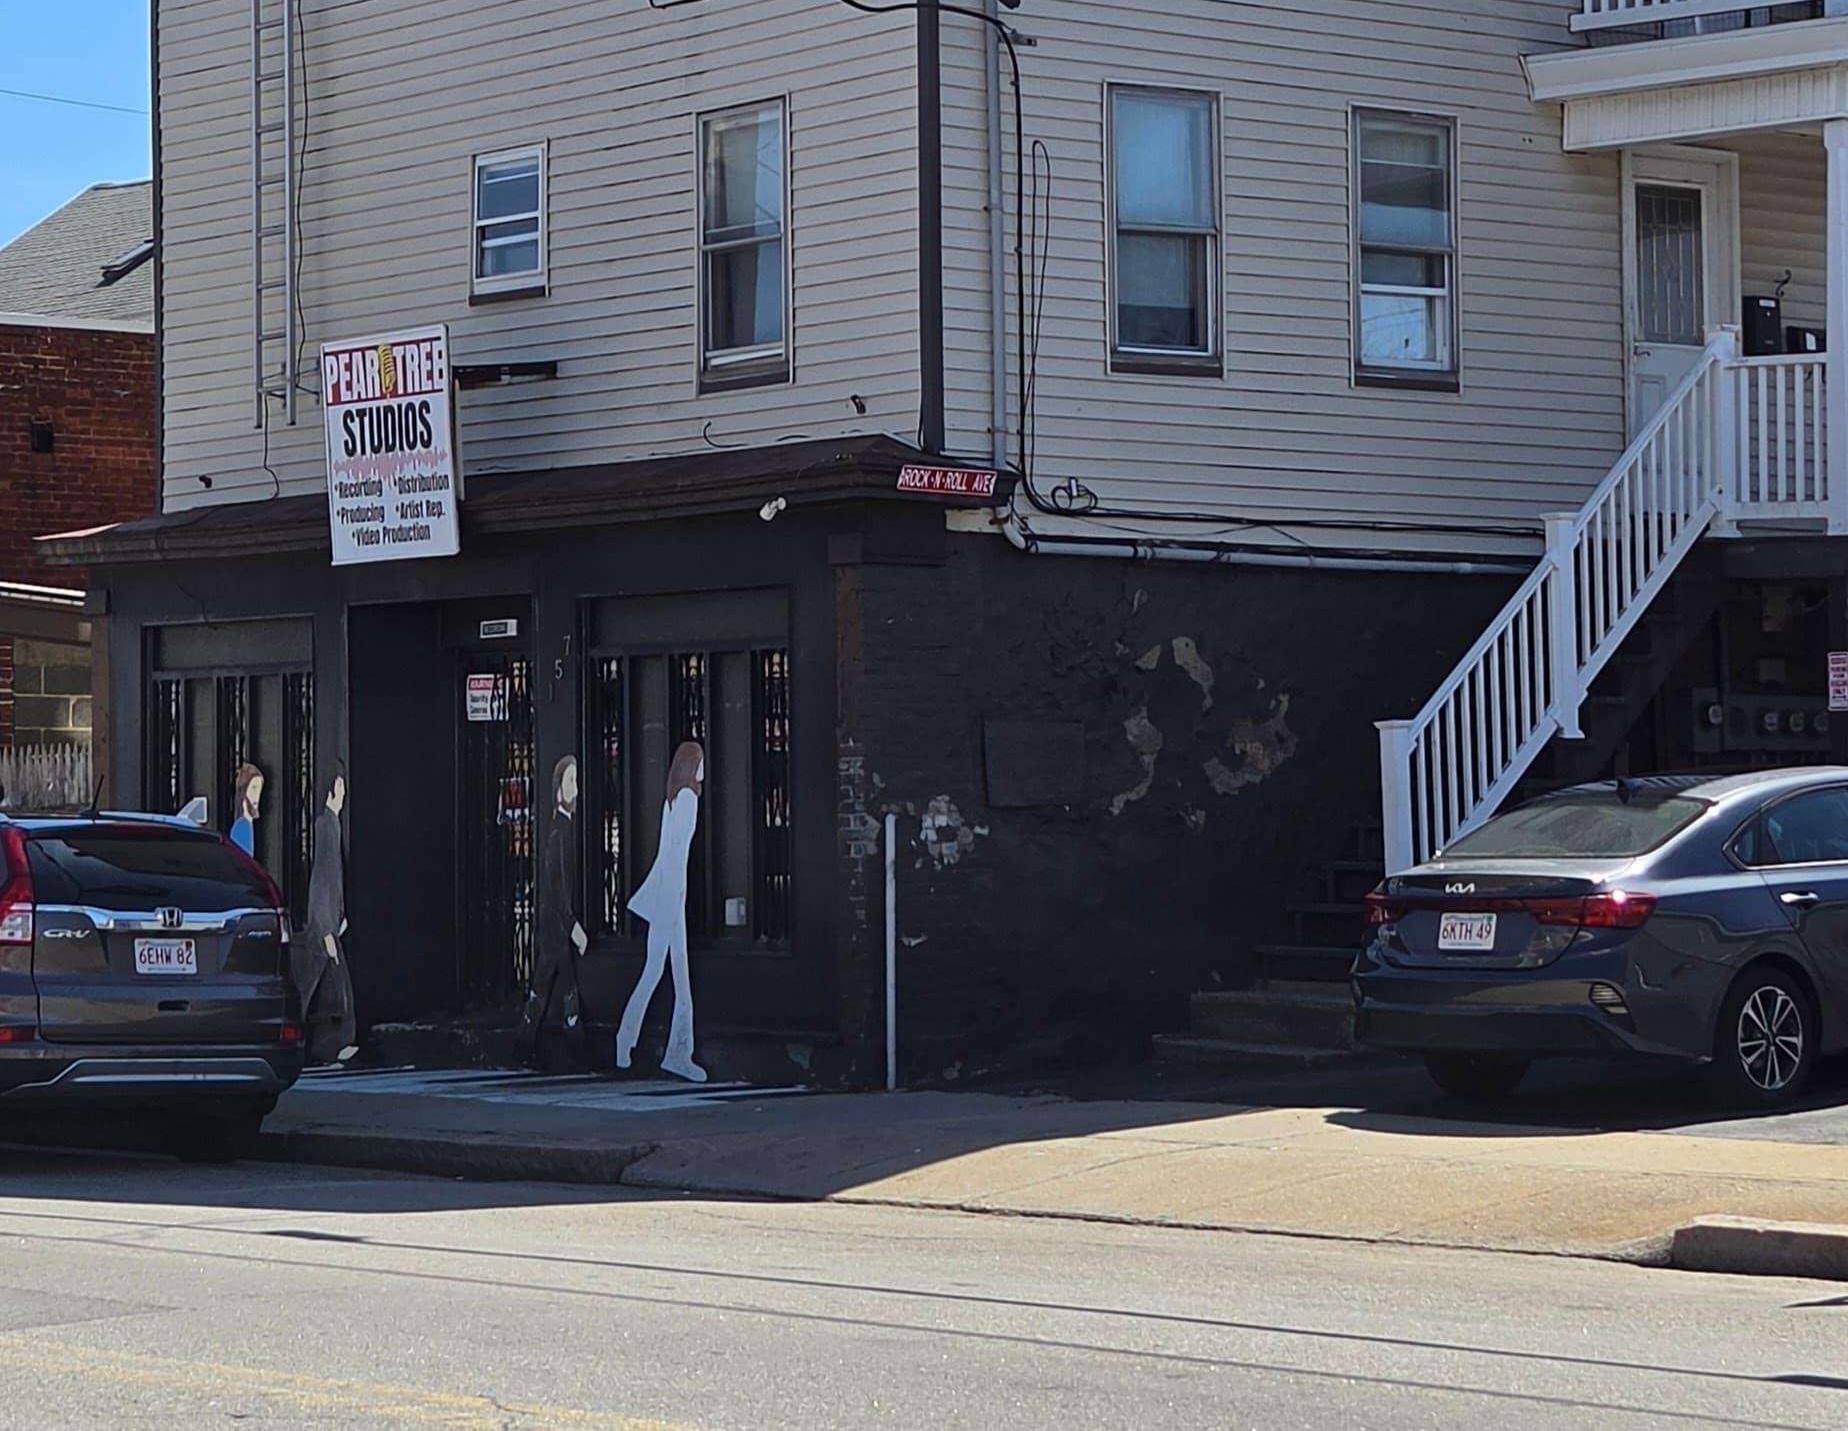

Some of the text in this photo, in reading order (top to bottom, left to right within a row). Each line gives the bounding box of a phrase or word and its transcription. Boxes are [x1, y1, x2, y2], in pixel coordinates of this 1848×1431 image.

[325, 340, 444, 403] PEAR TREE
[342, 400, 433, 458] STUDIOS
[338, 477, 383, 499] Recording
[398, 472, 450, 495] Distribution
[972, 474, 992, 492] AVE
[341, 503, 385, 525] Producing
[400, 499, 446, 520] Artist Rep.
[356, 522, 431, 547] Video Production
[1442, 921, 1492, 940] 6KTH 49
[139, 947, 193, 965] 6EHW 82
